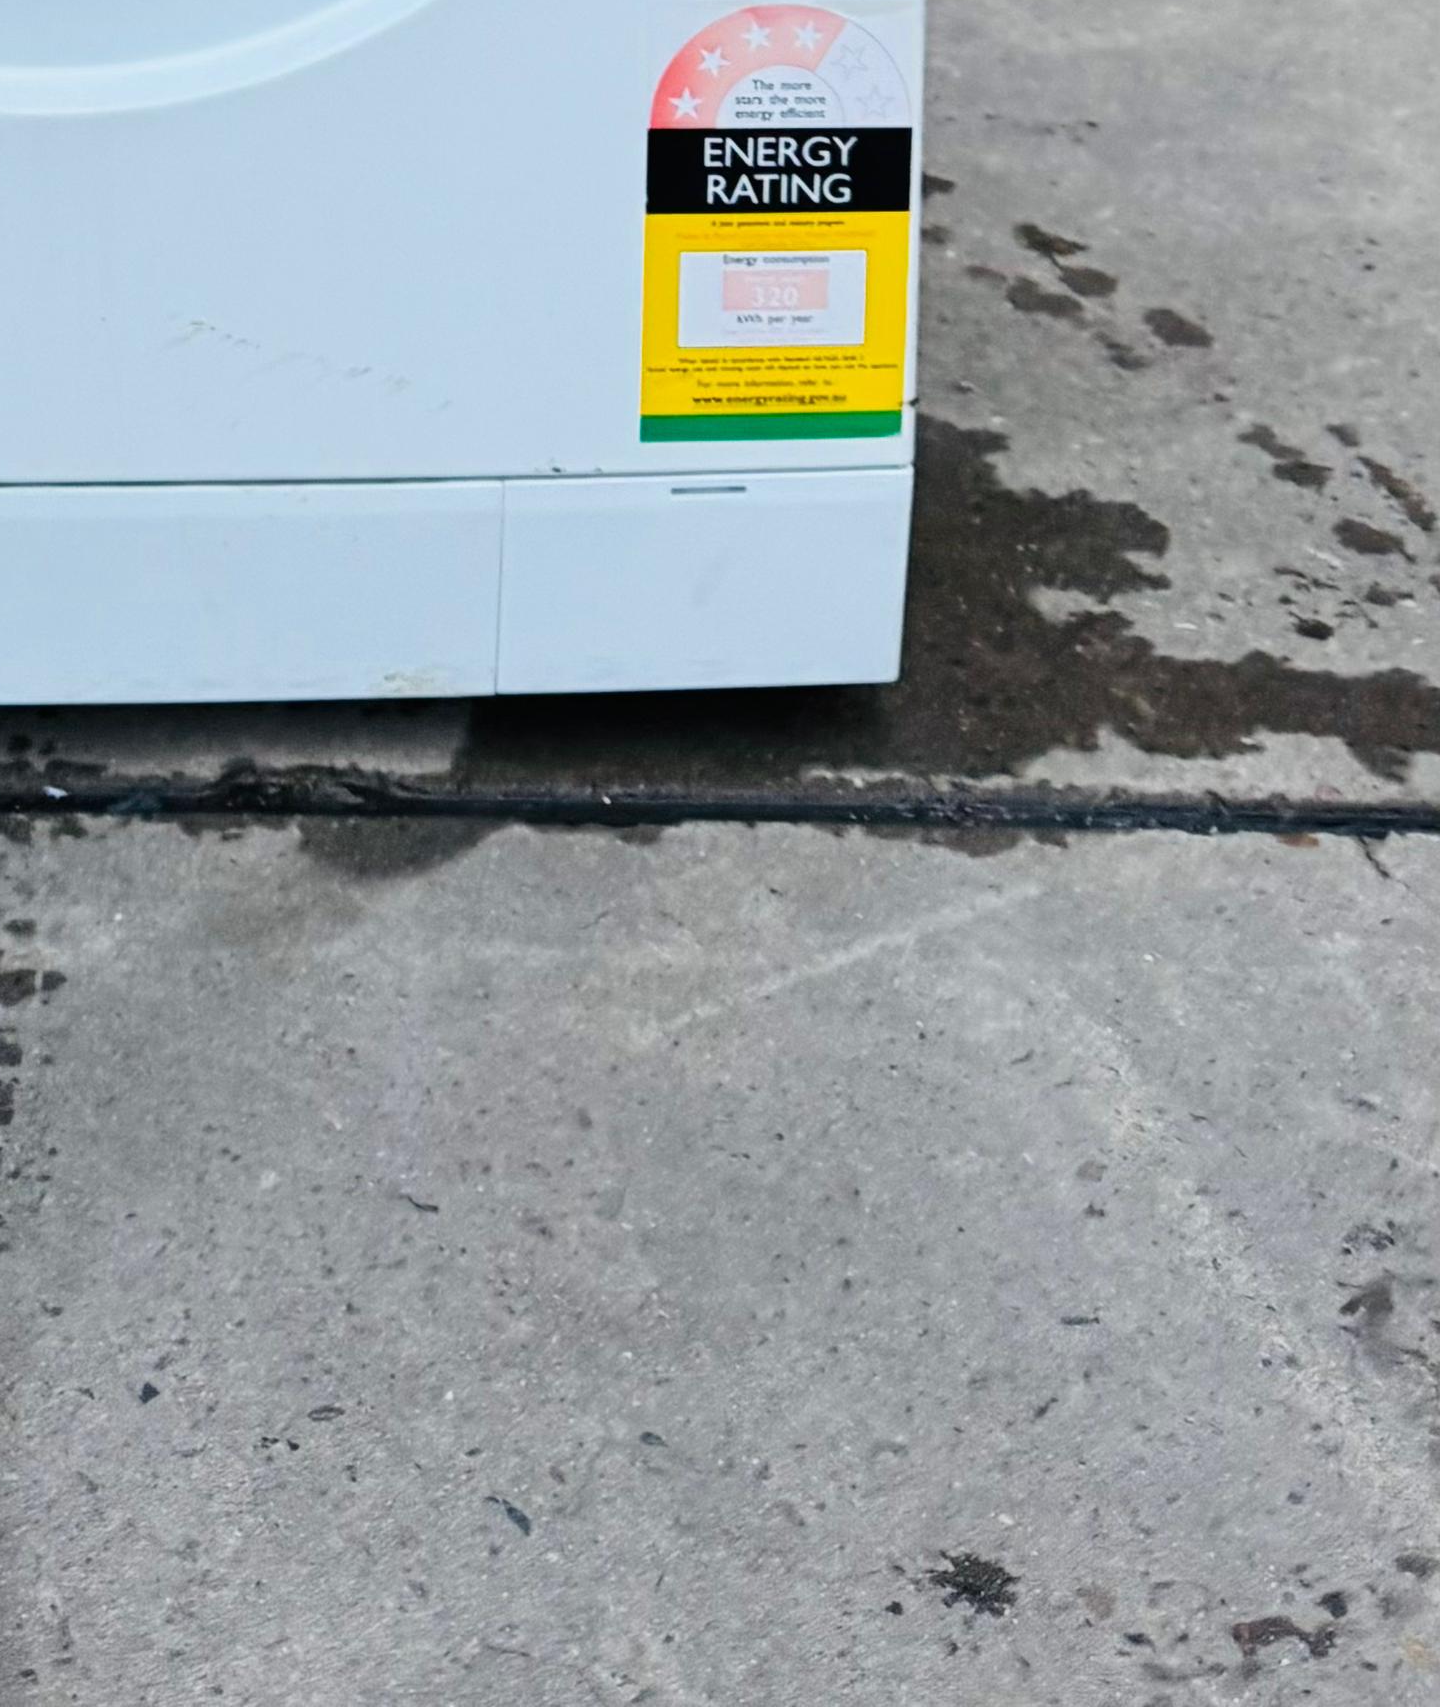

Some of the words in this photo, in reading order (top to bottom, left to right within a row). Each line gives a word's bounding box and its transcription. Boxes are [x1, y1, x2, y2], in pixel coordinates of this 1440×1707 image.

[752, 79, 775, 91] The
[780, 82, 812, 91] more
[735, 96, 762, 105] stars
[769, 94, 788, 105] the
[794, 96, 826, 105] more
[735, 110, 774, 122] energy
[780, 107, 825, 119] efficient
[703, 136, 858, 167] ENERGY
[706, 173, 852, 205] RATING
[722, 254, 757, 266] Energy
[763, 255, 830, 266] consumption
[752, 286, 800, 308] 320
